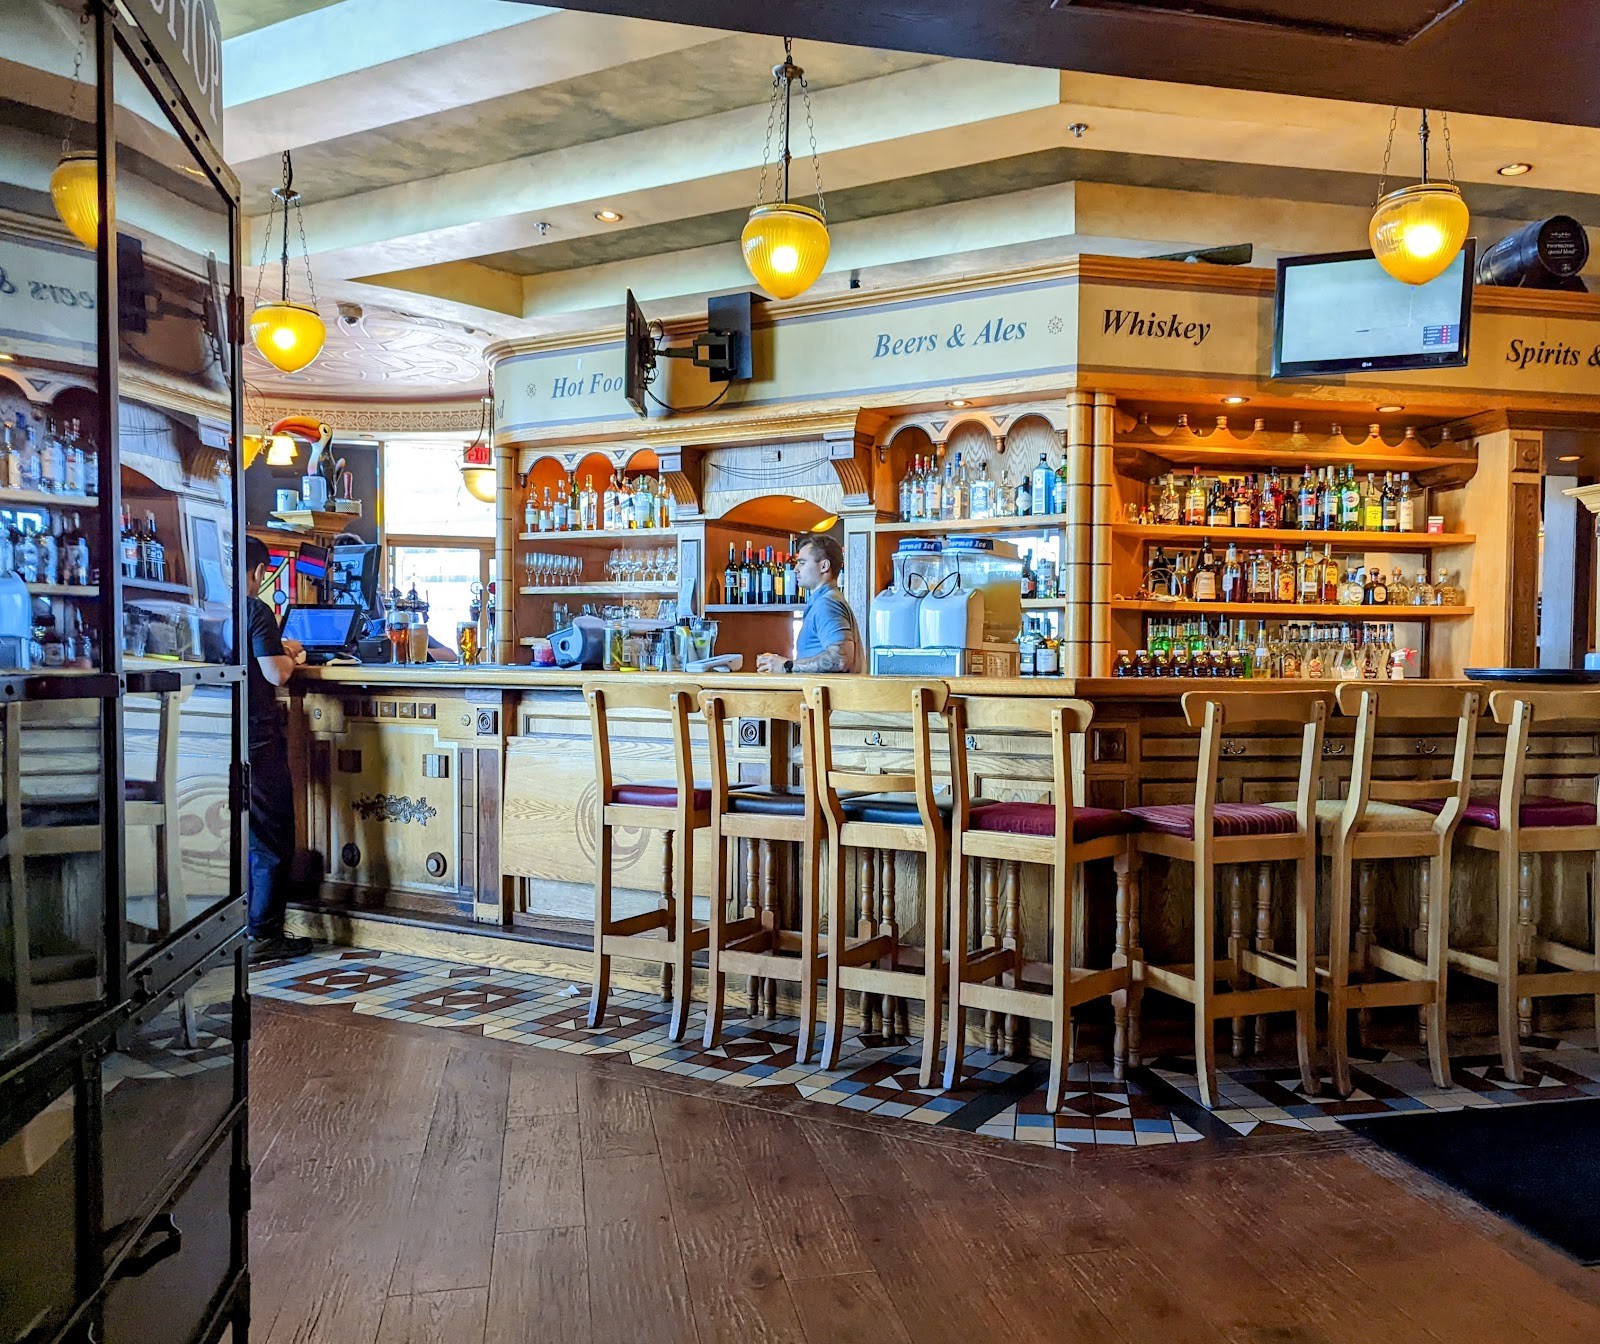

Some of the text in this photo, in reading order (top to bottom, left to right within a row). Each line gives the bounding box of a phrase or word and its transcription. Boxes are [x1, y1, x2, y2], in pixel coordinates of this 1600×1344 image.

[873, 317, 1028, 358] Beers & Ales
[1103, 309, 1211, 346] Whiskey
[1506, 339, 1581, 370] Spirits
[551, 373, 623, 399] Hot Foo
